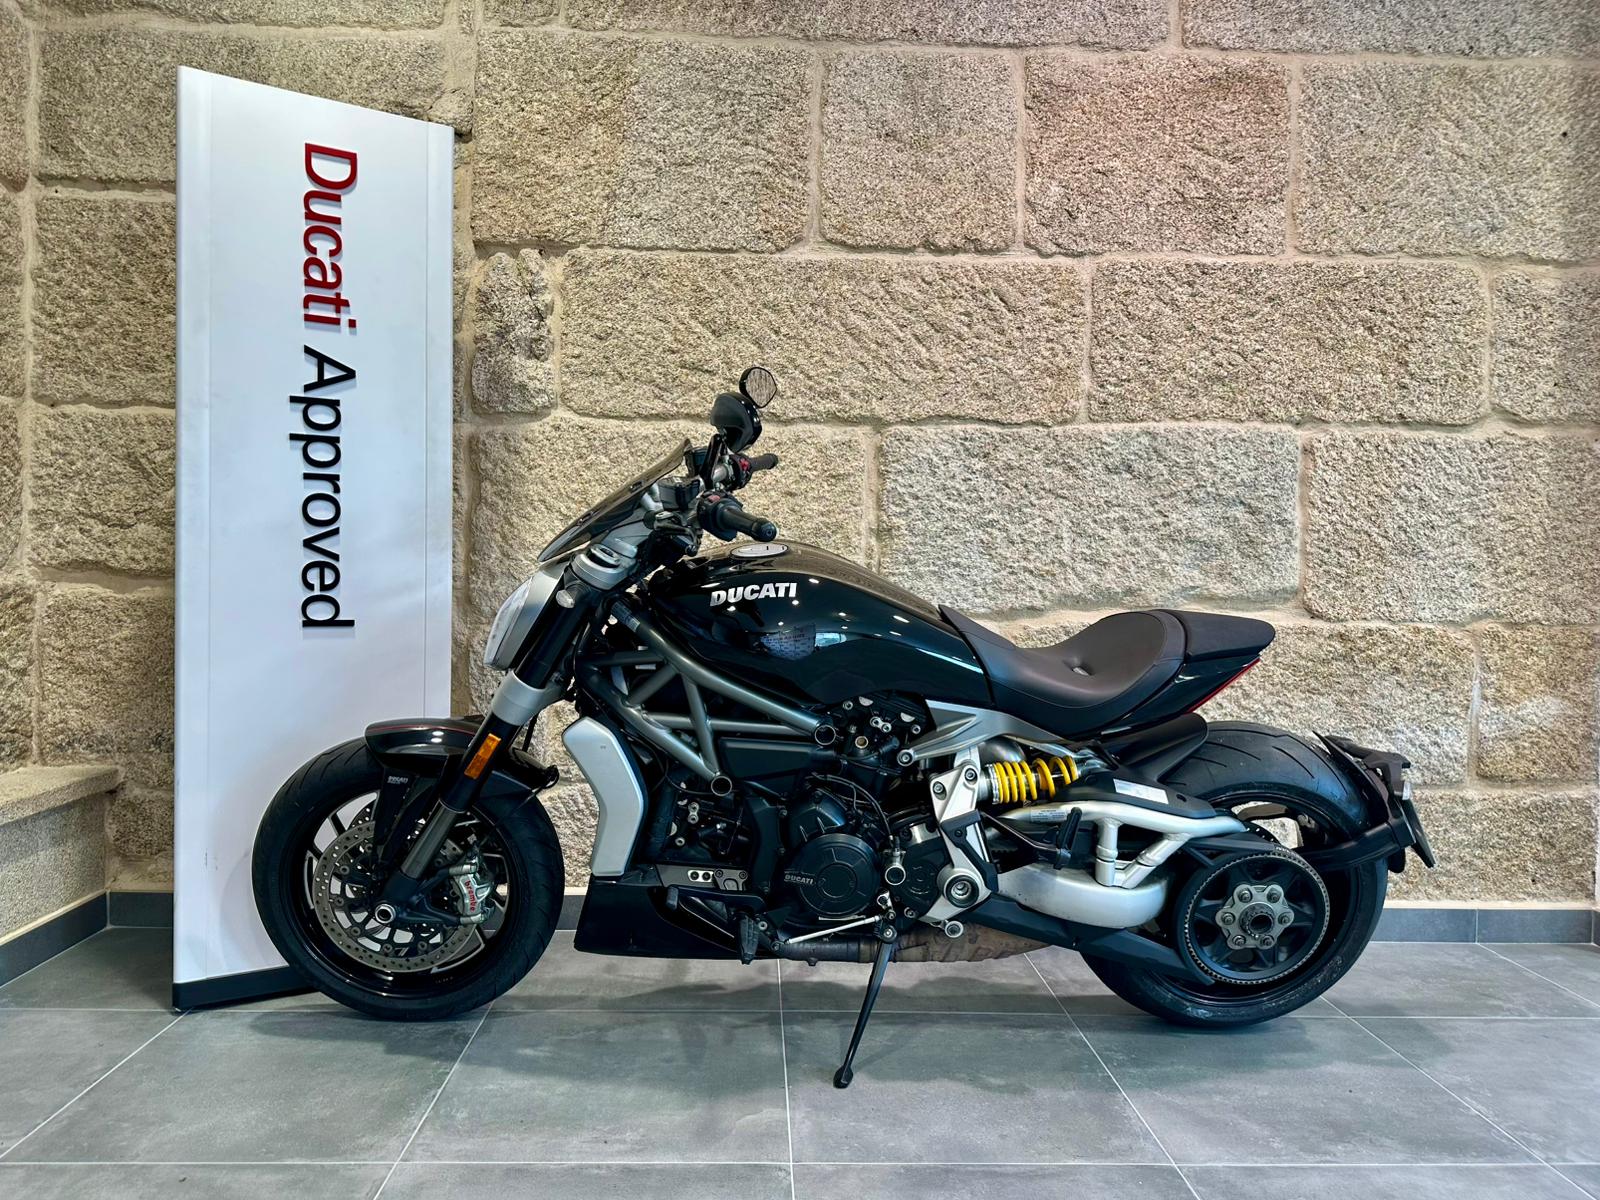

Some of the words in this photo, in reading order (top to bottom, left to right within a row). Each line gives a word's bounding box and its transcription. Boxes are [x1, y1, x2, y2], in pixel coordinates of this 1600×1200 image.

[303, 142, 358, 329] Ducati
[289, 344, 356, 628] Approved
[709, 582, 798, 607] DUCATI
[784, 874, 814, 885] DUCATI
